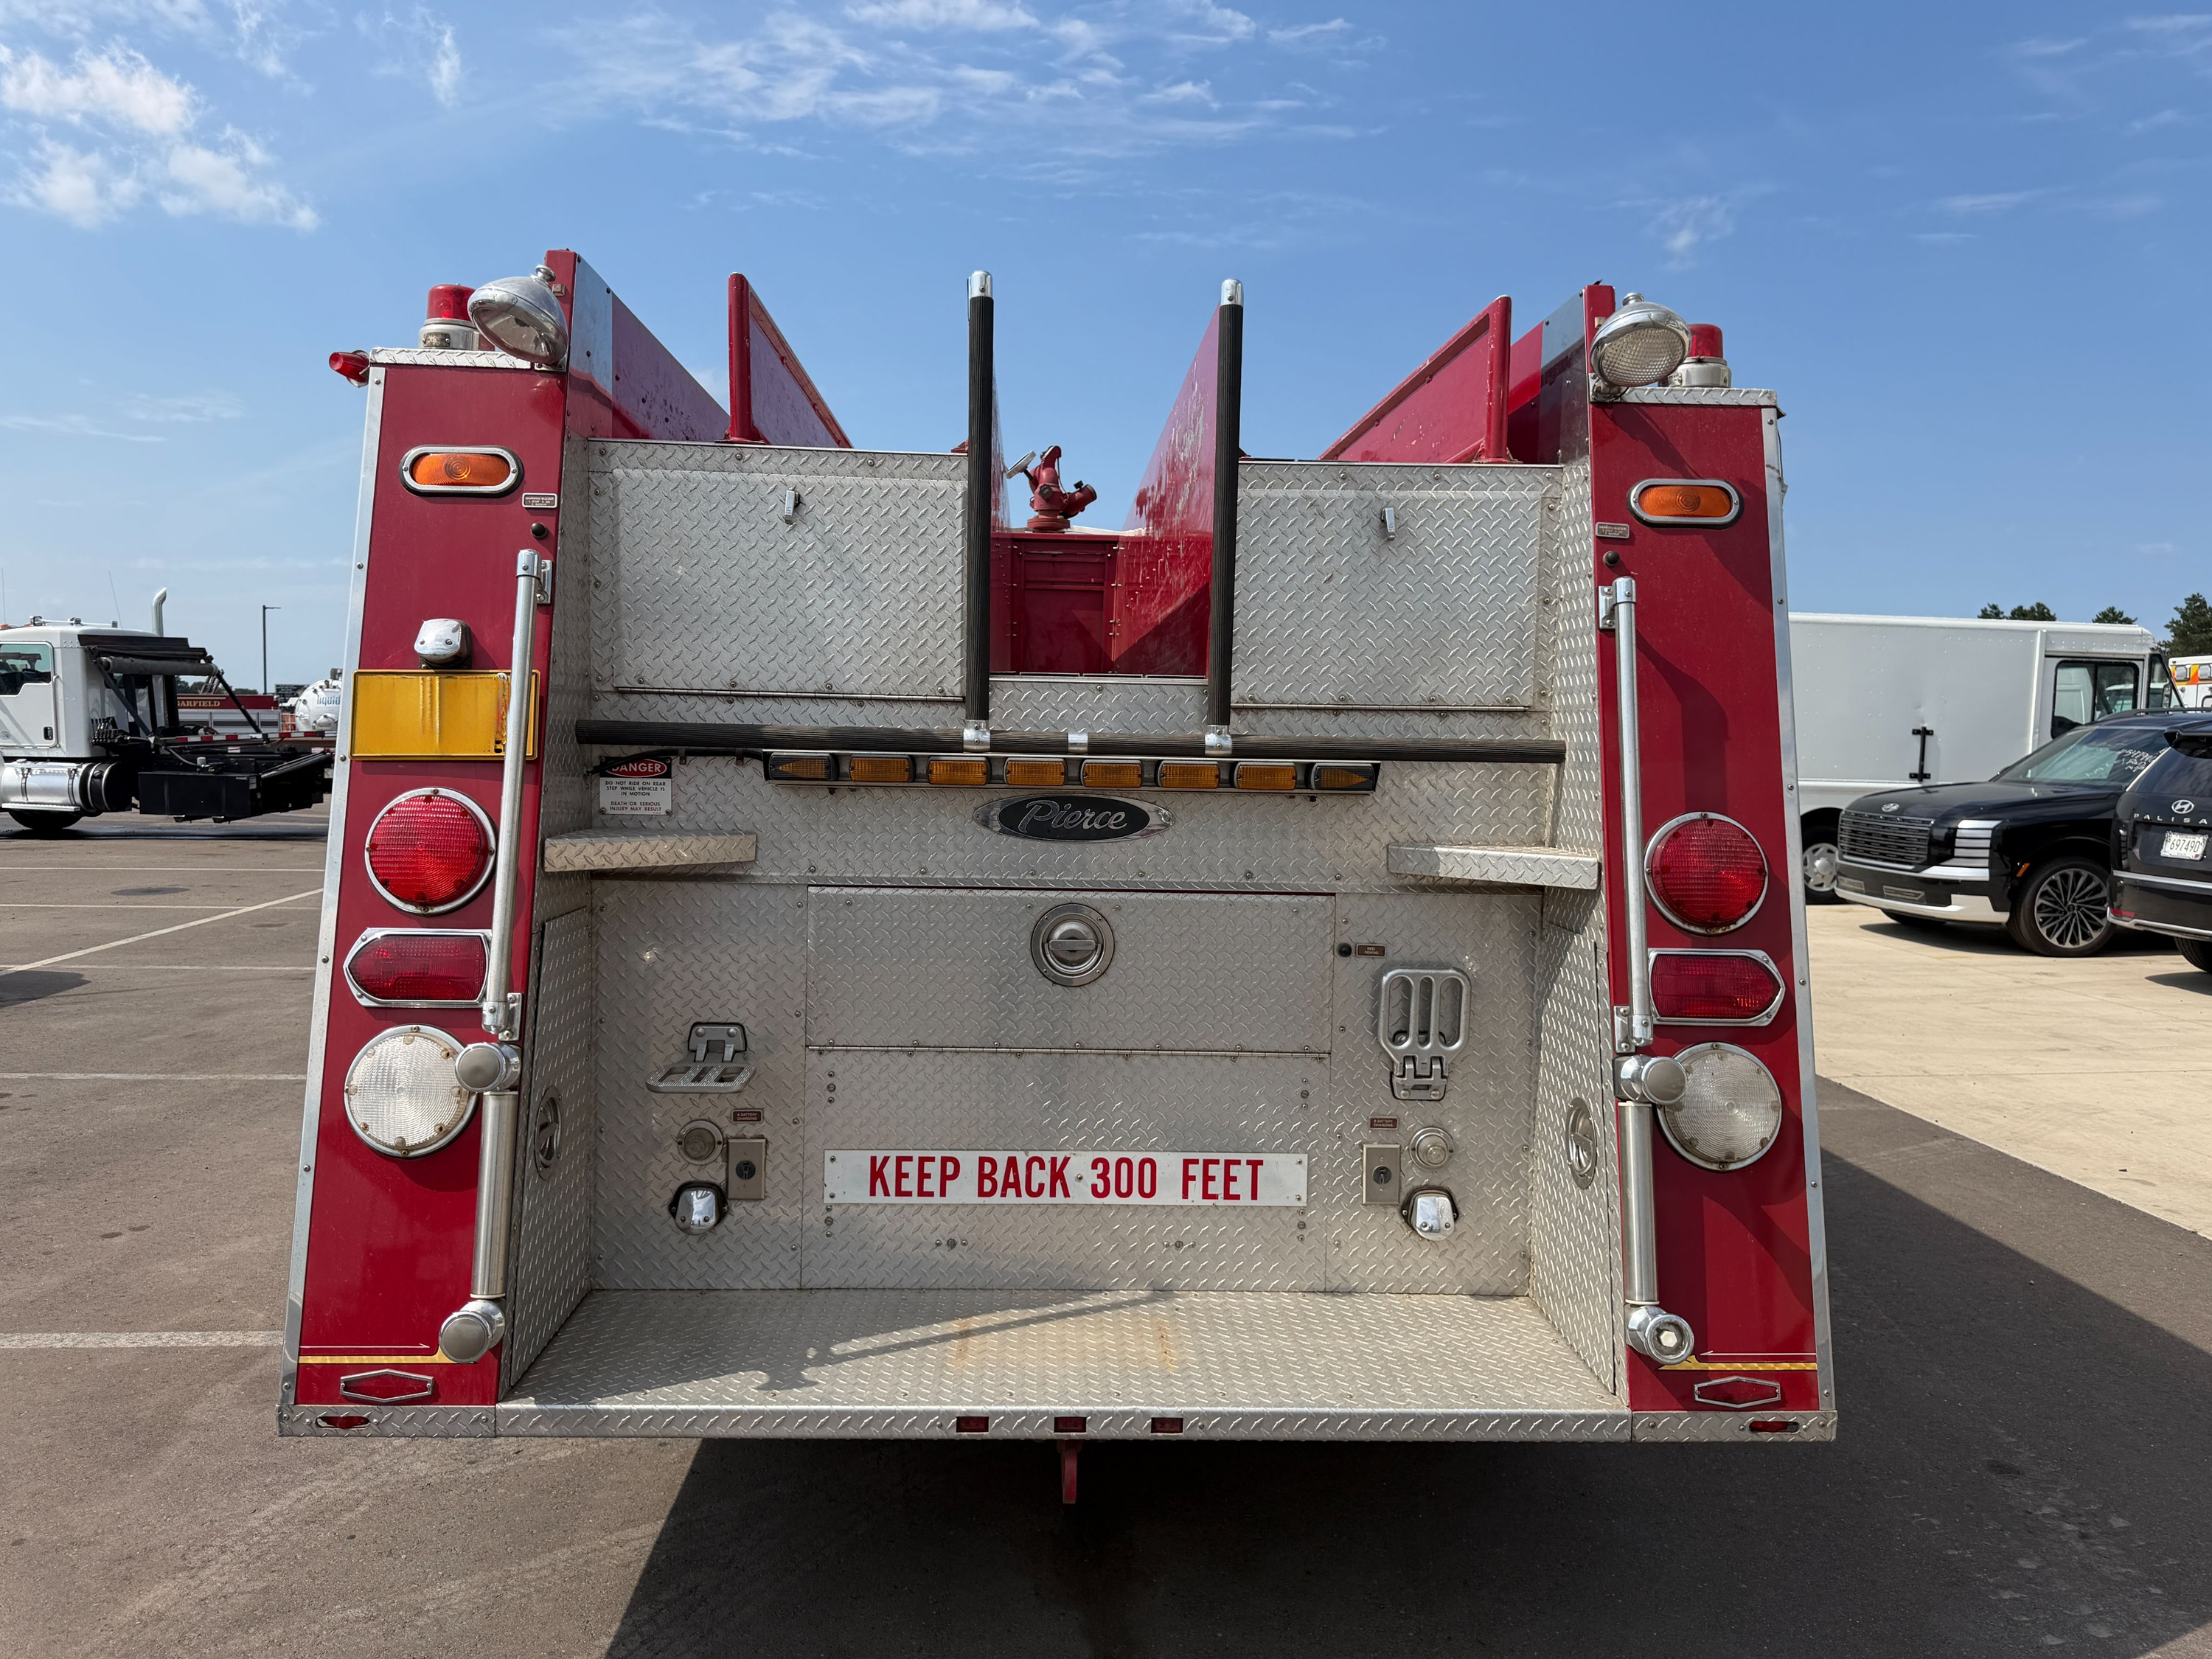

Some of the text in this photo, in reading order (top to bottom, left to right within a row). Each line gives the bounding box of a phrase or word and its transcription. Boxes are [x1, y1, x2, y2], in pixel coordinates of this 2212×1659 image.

[317, 695, 341, 706] liquid
[1018, 799, 1128, 835] Pierce
[869, 1155, 1264, 1200] KEEP BACK 300 FEET
